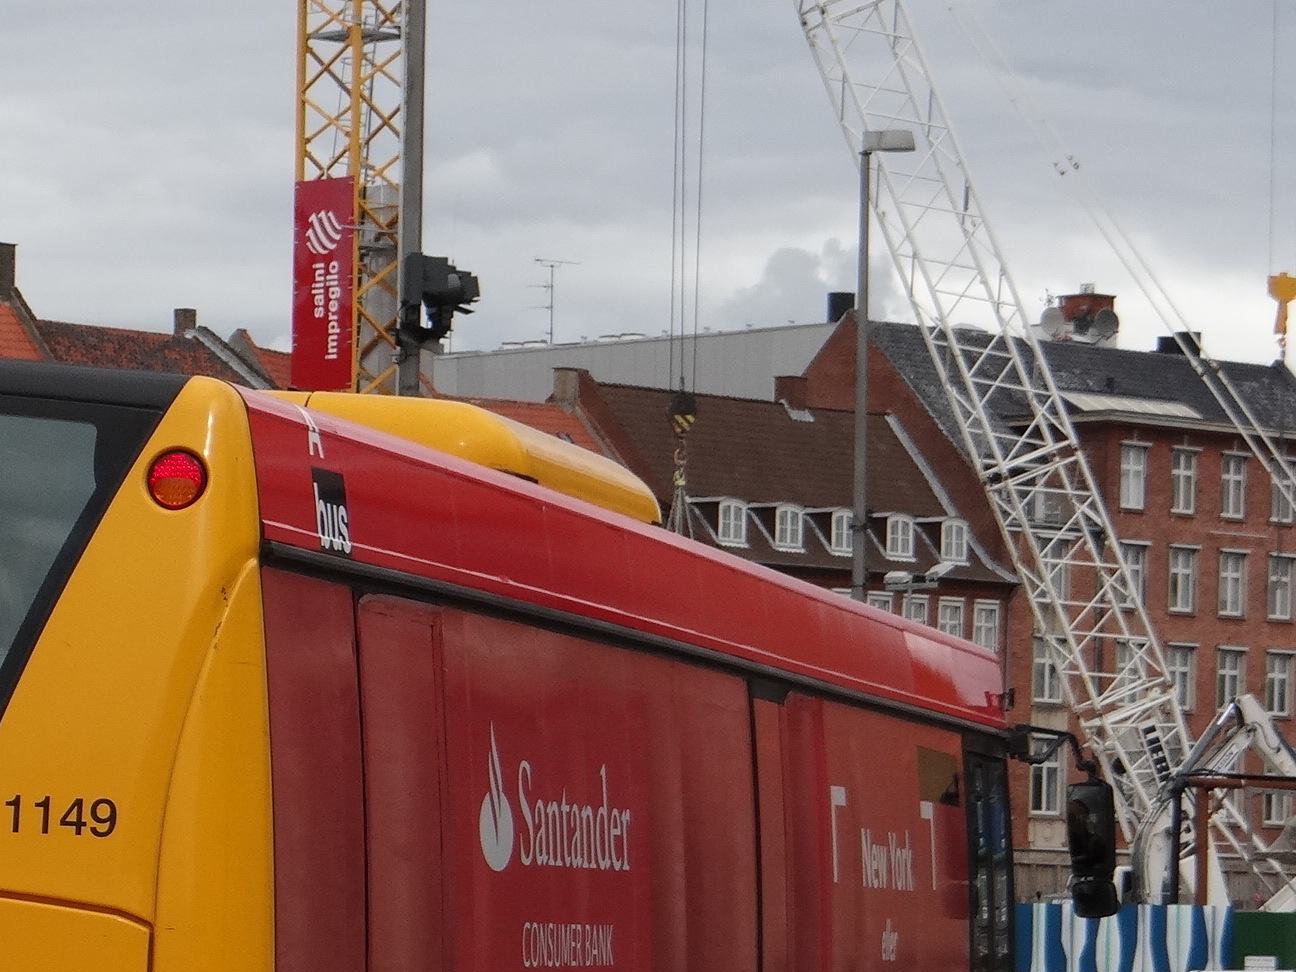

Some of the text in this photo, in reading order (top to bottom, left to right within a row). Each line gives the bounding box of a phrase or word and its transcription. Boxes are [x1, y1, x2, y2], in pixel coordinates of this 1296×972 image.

[312, 263, 325, 318] salini
[325, 261, 339, 359] impregilo
[313, 482, 352, 554] bus
[5, 794, 118, 838] 1149
[518, 760, 631, 871] Santander
[861, 828, 914, 891] New York
[522, 922, 614, 967] CONSUMER BANK
